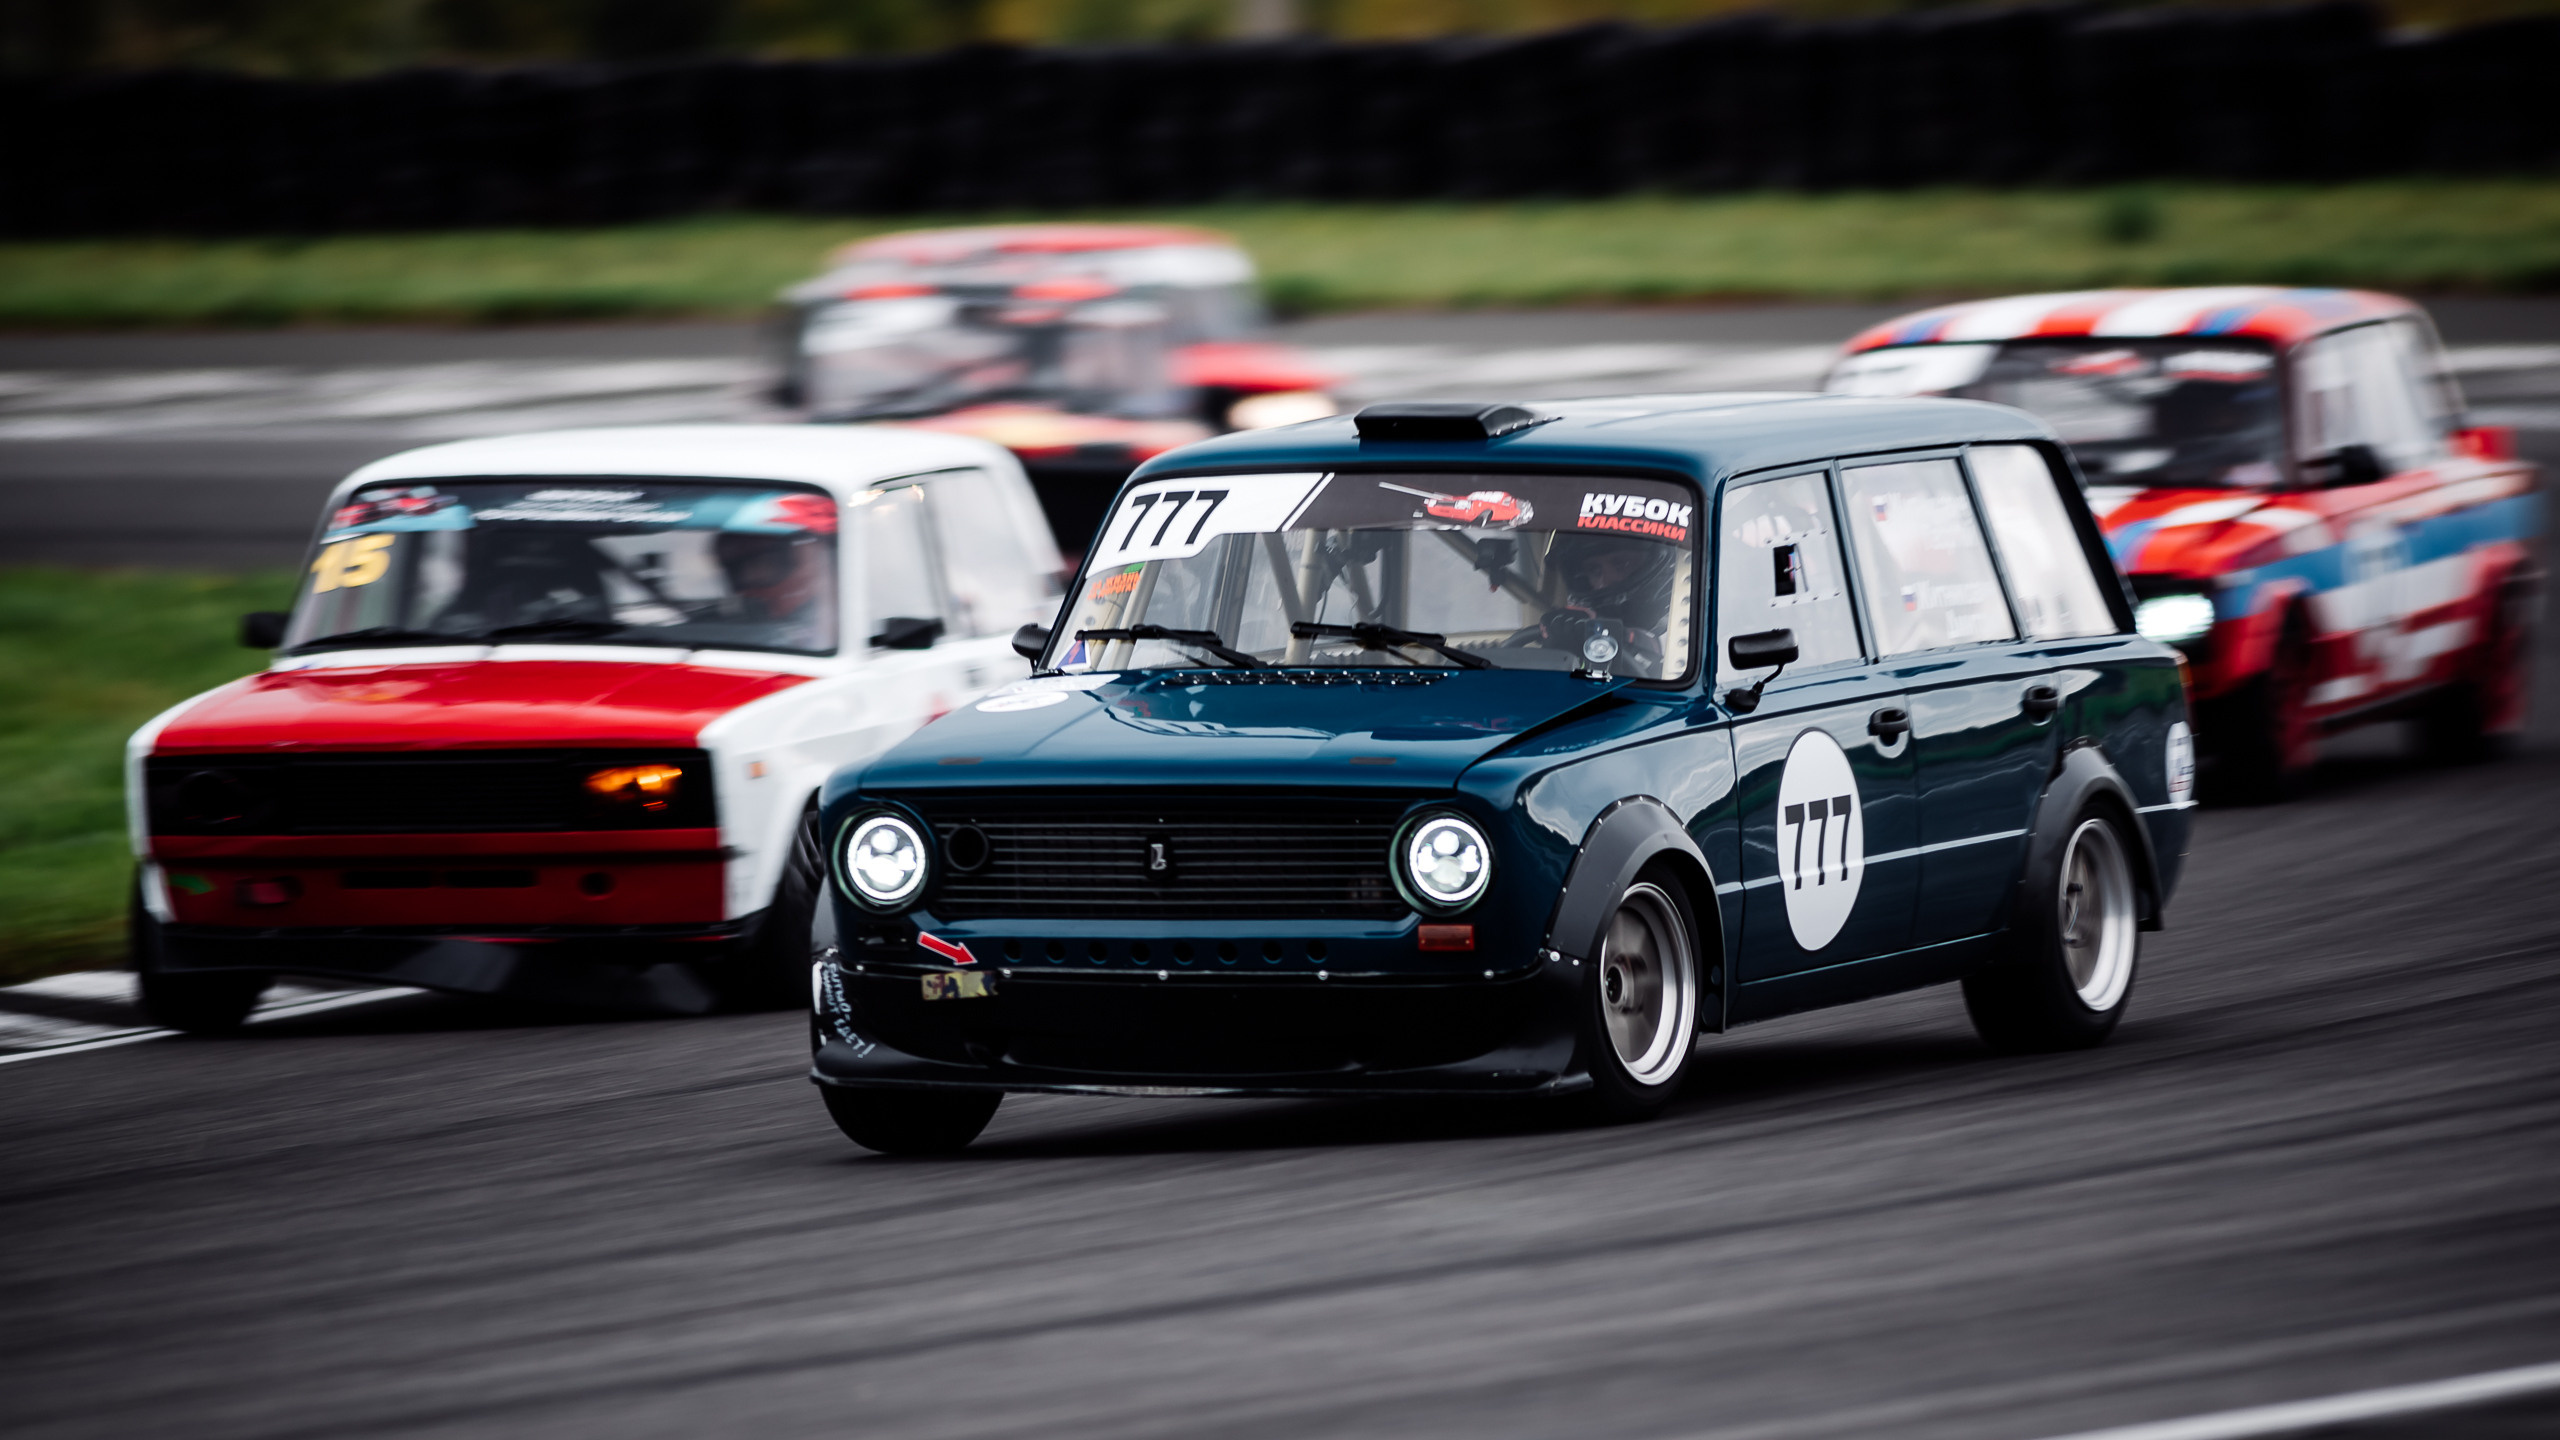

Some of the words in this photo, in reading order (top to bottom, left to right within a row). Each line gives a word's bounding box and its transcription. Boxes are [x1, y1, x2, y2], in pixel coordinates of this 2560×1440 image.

[1118, 489, 1230, 553] 777
[1577, 515, 1687, 542] КЛАССИКИ
[1579, 493, 1693, 528] КУБОК
[311, 534, 396, 595] 15
[1784, 794, 1852, 891] 777
